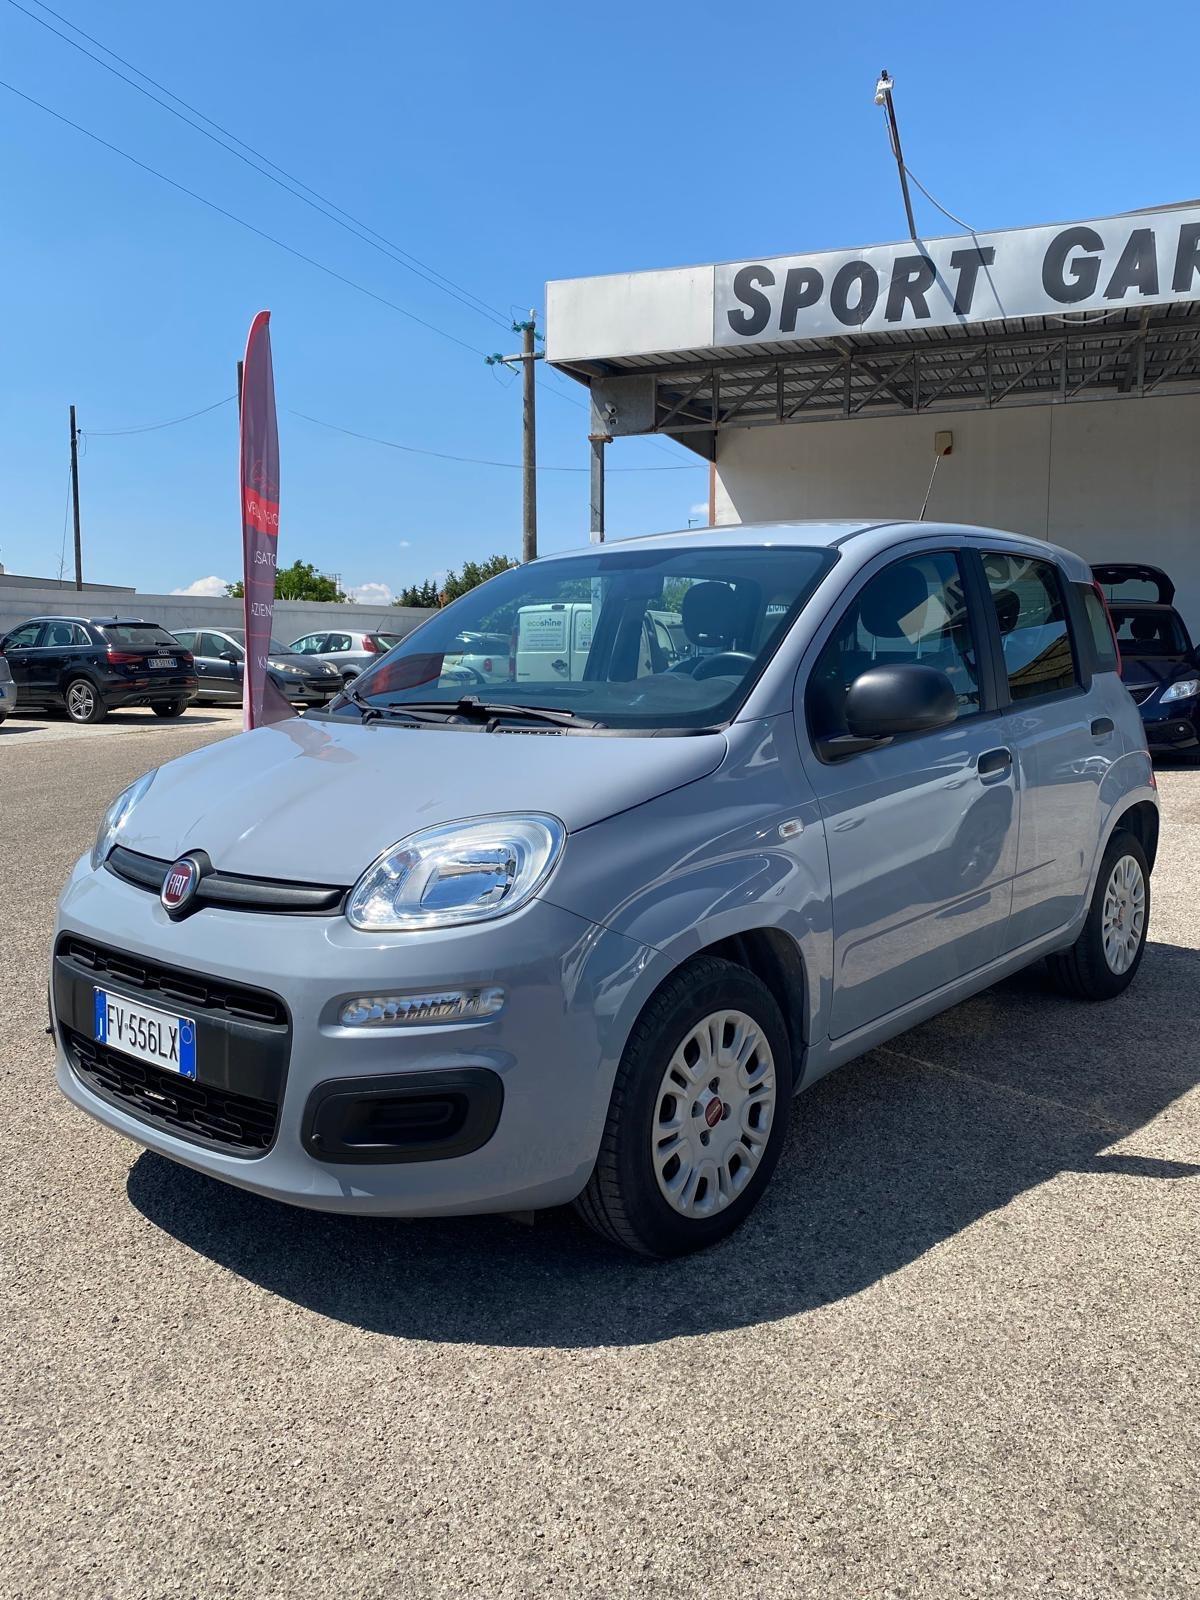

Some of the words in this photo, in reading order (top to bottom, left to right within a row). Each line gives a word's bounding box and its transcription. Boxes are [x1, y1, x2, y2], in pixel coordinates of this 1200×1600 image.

[727, 246, 996, 337] SPORT
[527, 618, 562, 627] ecoshine
[166, 873, 189, 896] FIAT
